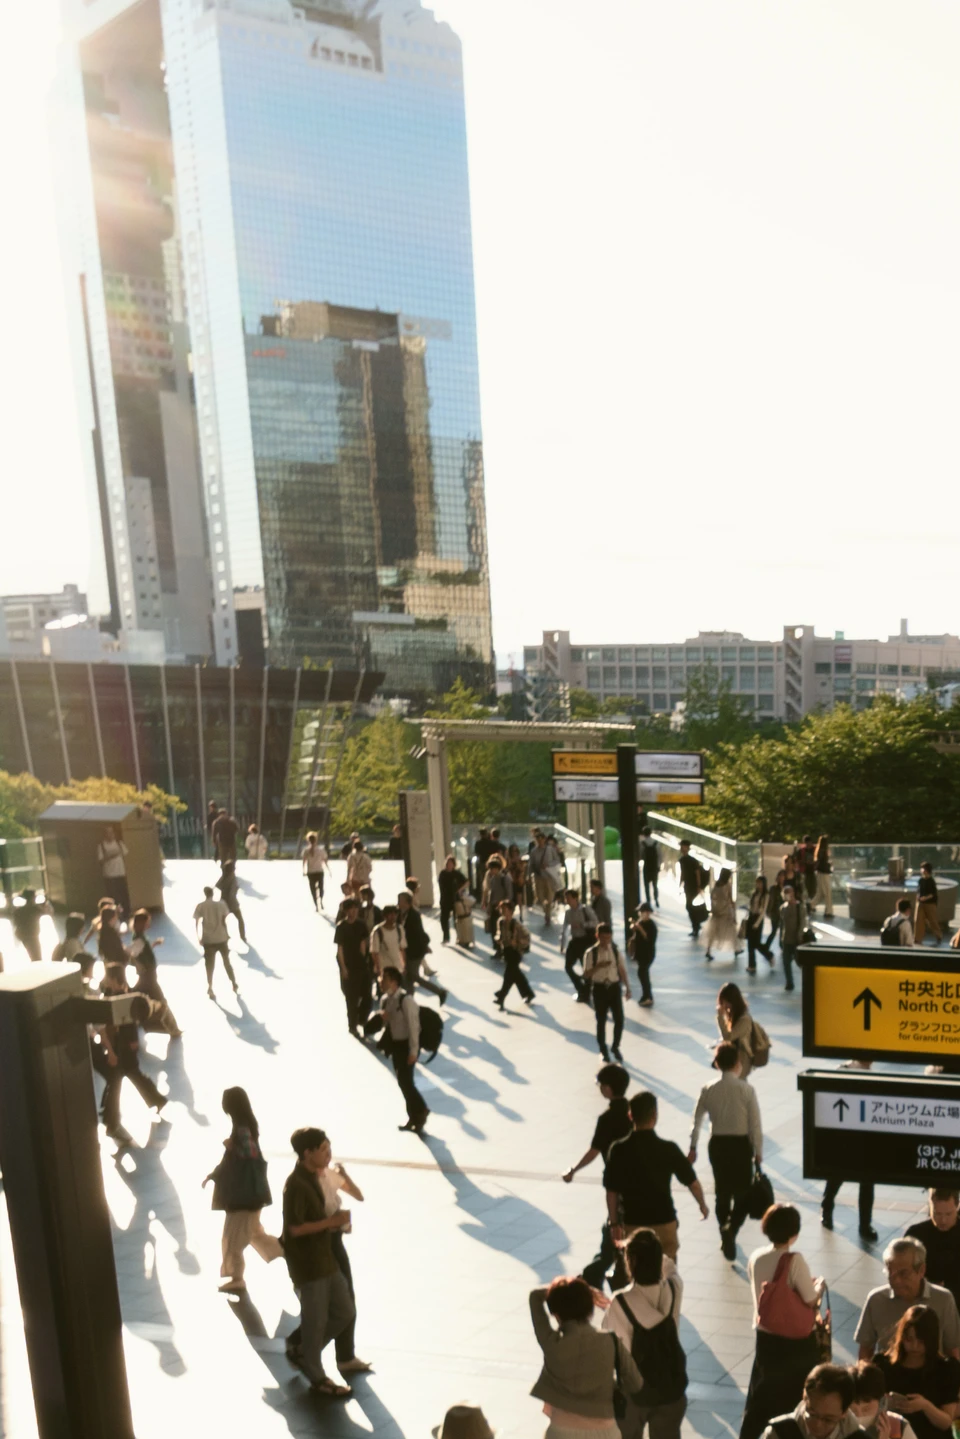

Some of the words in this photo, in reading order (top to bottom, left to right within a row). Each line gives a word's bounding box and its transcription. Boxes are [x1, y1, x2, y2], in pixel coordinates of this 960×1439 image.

[898, 999, 938, 1013] North
[898, 1032, 911, 1041] for
[912, 1033, 938, 1043] Grand
[871, 1101, 960, 1119] アトリウム広場
[871, 1115, 906, 1126] Atrium
[908, 1117, 935, 1128] Plaza
[917, 1145, 946, 1158] (3F)
[916, 1158, 928, 1169] JR
